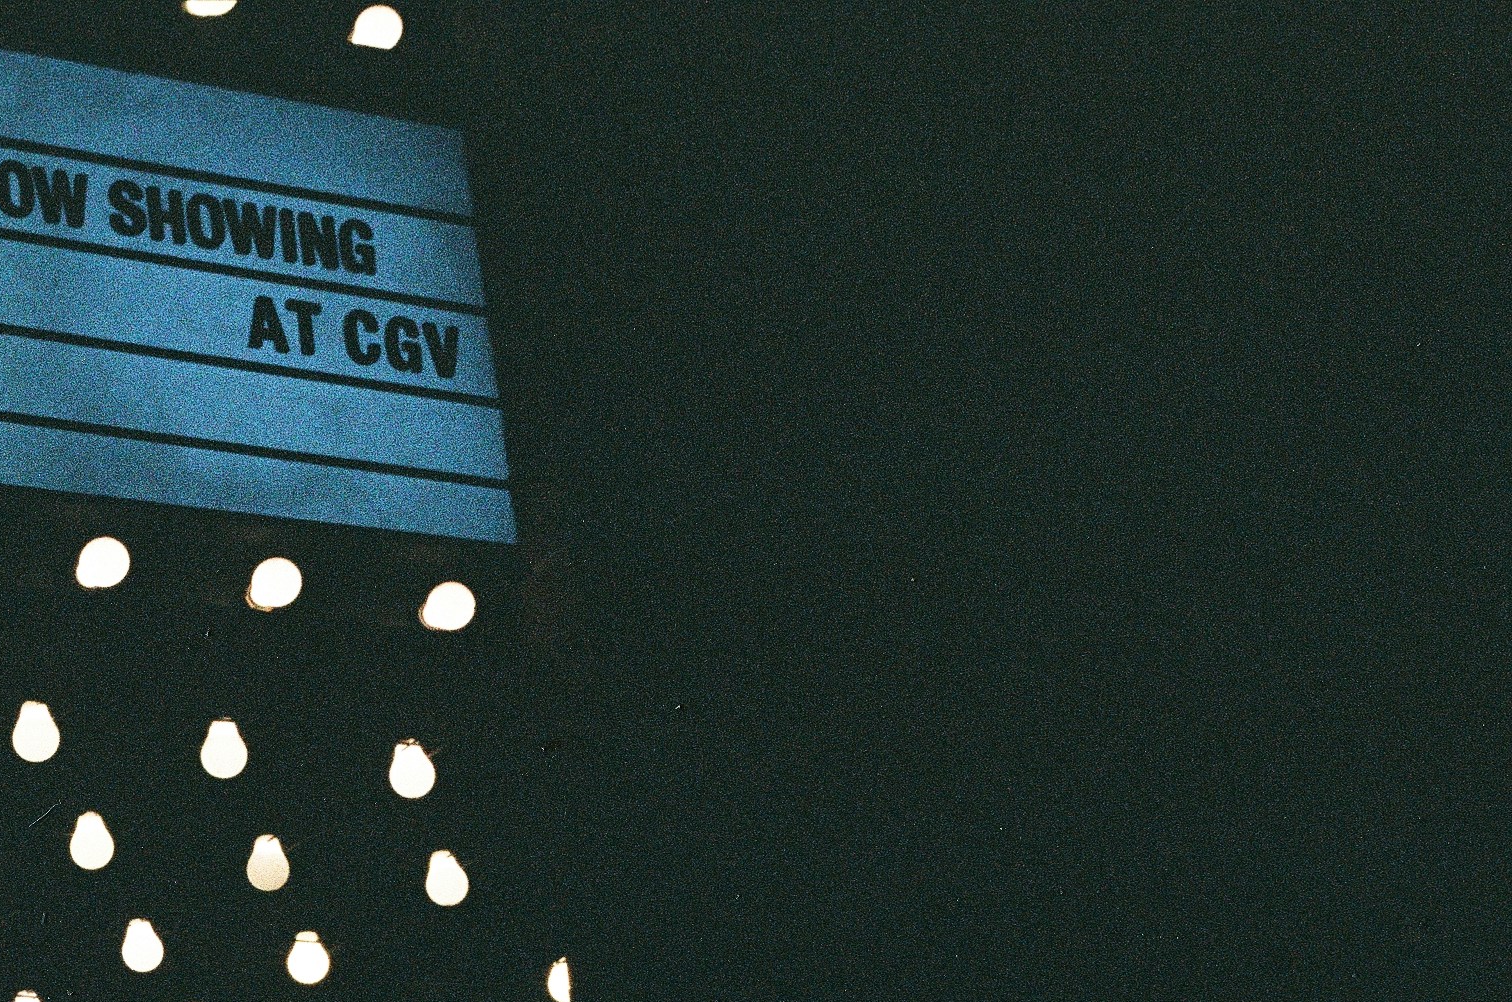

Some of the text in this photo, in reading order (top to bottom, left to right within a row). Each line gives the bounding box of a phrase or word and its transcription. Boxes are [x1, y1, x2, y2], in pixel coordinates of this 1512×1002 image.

[109, 179, 376, 275] SHOWING
[248, 296, 460, 378] AT CGV
